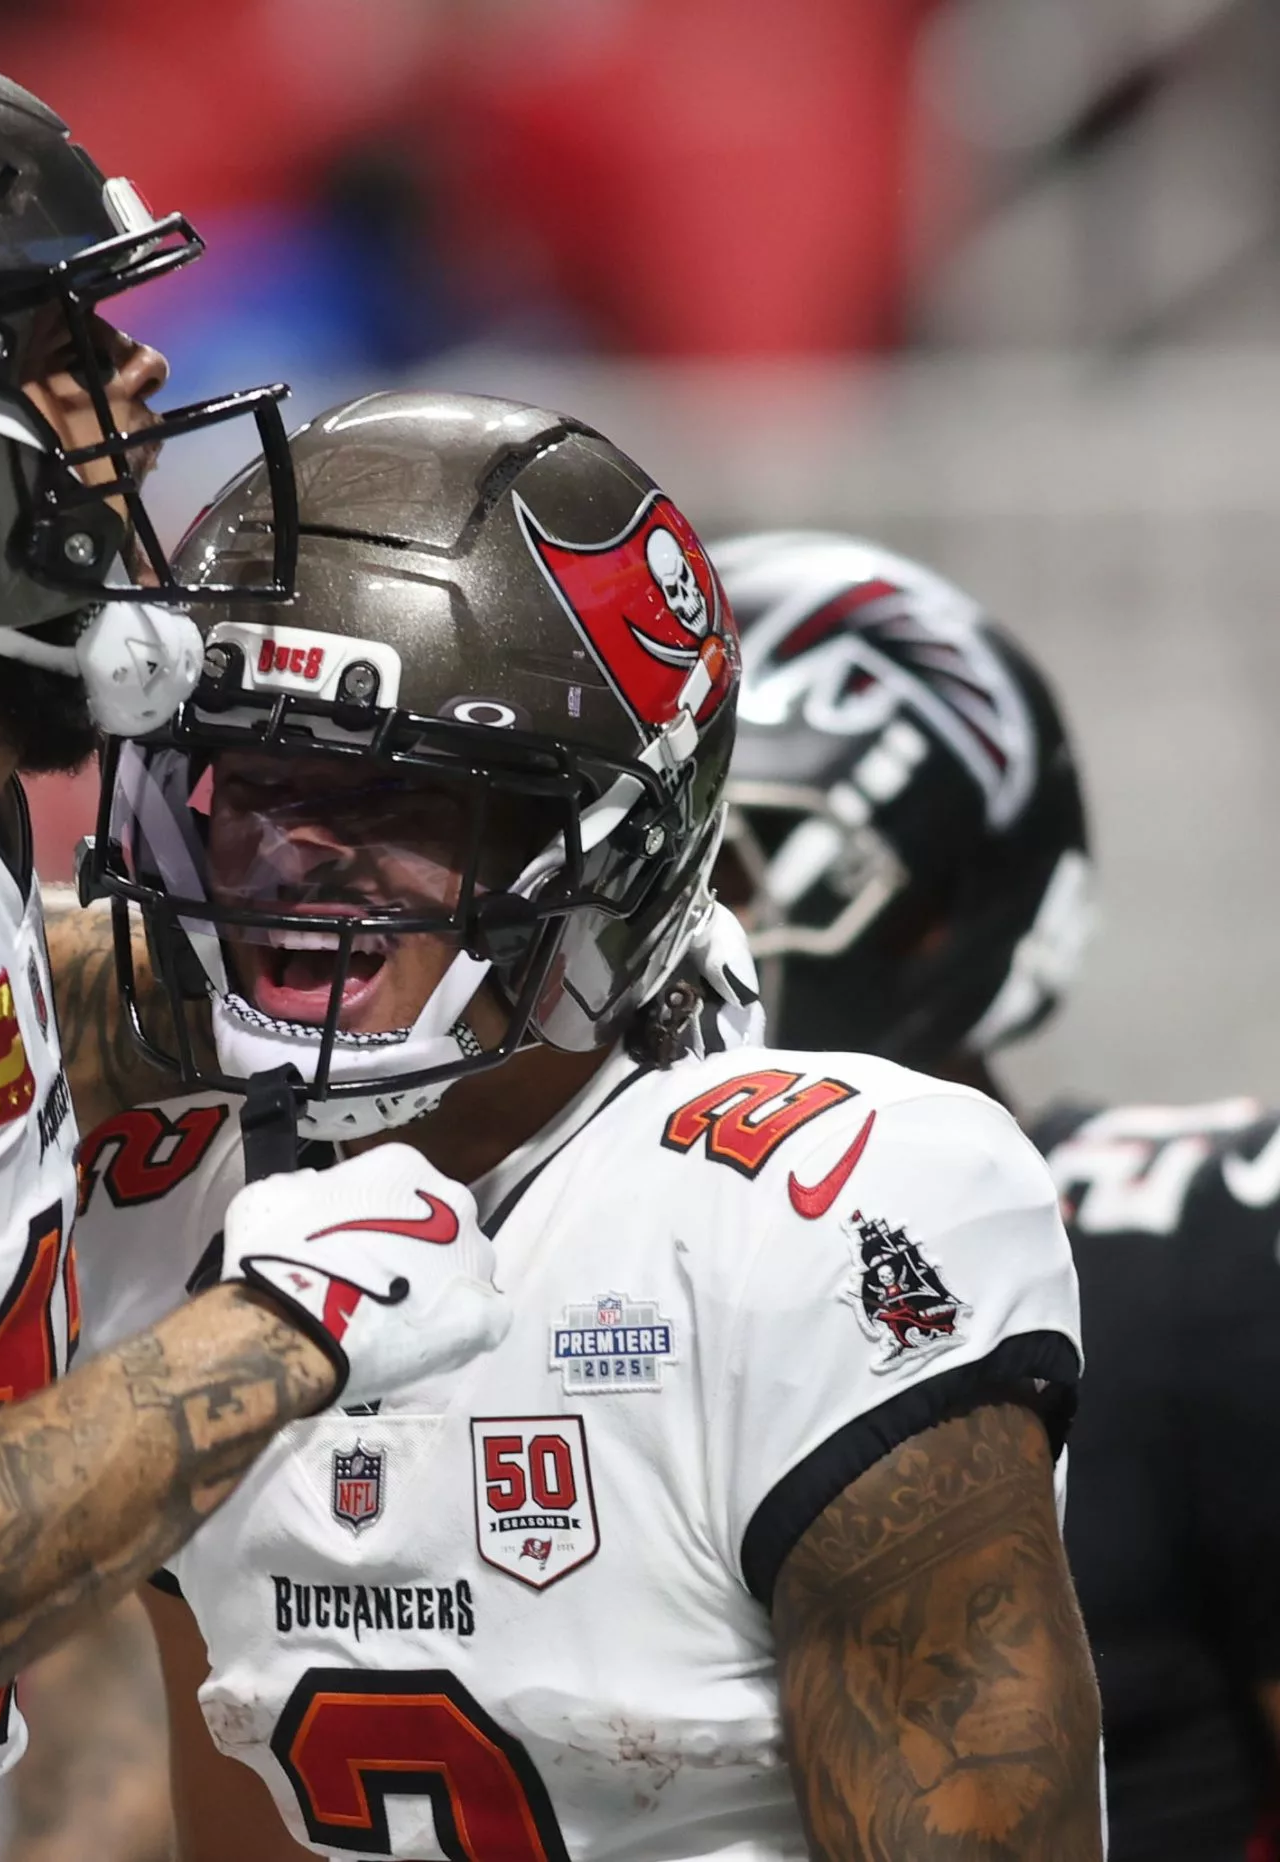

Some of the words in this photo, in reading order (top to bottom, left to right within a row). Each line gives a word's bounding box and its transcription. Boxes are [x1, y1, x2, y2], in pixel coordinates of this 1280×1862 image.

[660, 1068, 861, 1181] 2
[339, 1482, 375, 1516] NFL
[483, 1434, 577, 1513] 50
[502, 1516, 566, 1530] SEASONS
